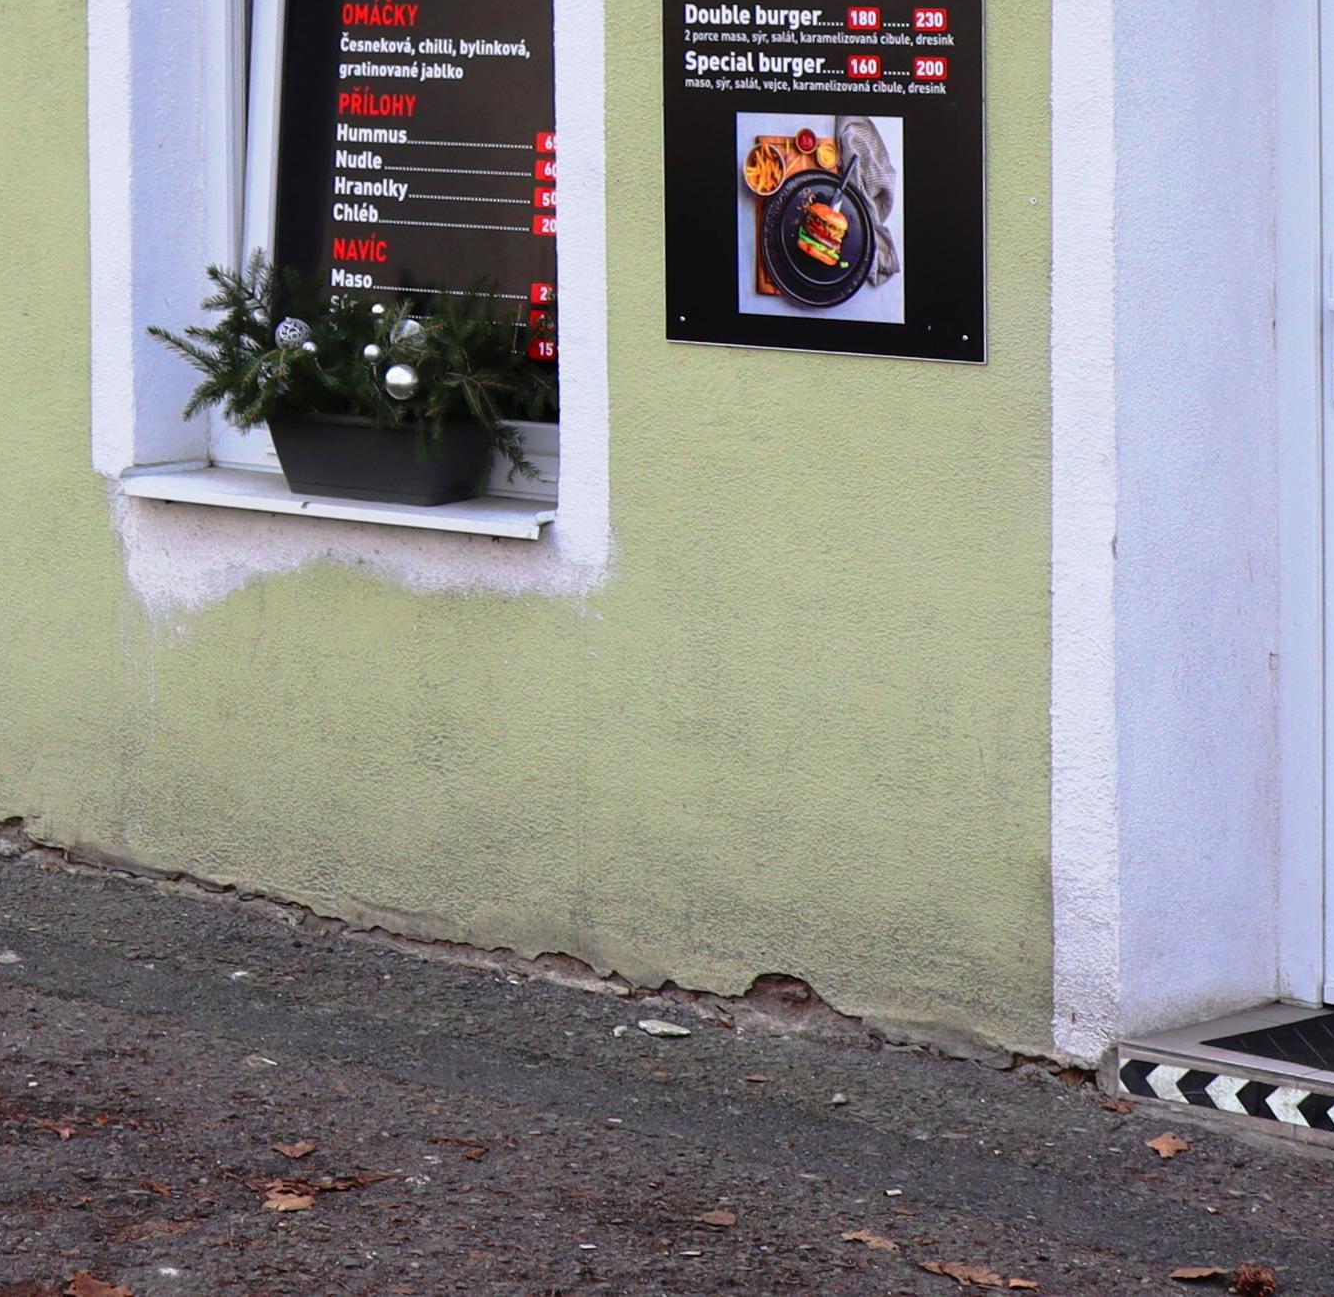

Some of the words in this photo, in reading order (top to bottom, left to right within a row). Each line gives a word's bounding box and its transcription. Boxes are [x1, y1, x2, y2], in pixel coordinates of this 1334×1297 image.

[684, 3, 750, 25] Double
[850, 10, 876, 26] 180
[916, 11, 943, 28] 230
[340, 32, 416, 56] Česneková,
[419, 38, 456, 57] chilli,
[460, 39, 530, 59] bylinková,
[692, 32, 720, 45] porce
[721, 33, 750, 44] masa,
[752, 30, 769, 45] sýr,
[771, 30, 798, 44] salát,
[800, 31, 878, 45] karamelizovaná
[880, 32, 914, 47] cibule,
[916, 33, 955, 46] dresink
[339, 61, 417, 79] gratinované
[420, 63, 464, 81] jablko
[685, 50, 754, 76] Special
[850, 58, 877, 75] 160
[916, 60, 944, 76] 200
[684, 78, 713, 90] maso,
[716, 76, 732, 91] sýr,
[734, 77, 761, 91] salát,
[763, 79, 790, 93] vejce,
[792, 78, 870, 93] karamelizovaná
[872, 80, 906, 95] cibule,
[908, 81, 947, 94] dresink
[338, 86, 417, 117] PŘÍLOHY
[337, 123, 408, 144] Hummus
[336, 150, 382, 169] Nudle
[334, 176, 408, 201] Hranolky
[333, 203, 379, 224] Chléb
[332, 233, 388, 262] NAVÍC
[331, 268, 373, 289] Maso
